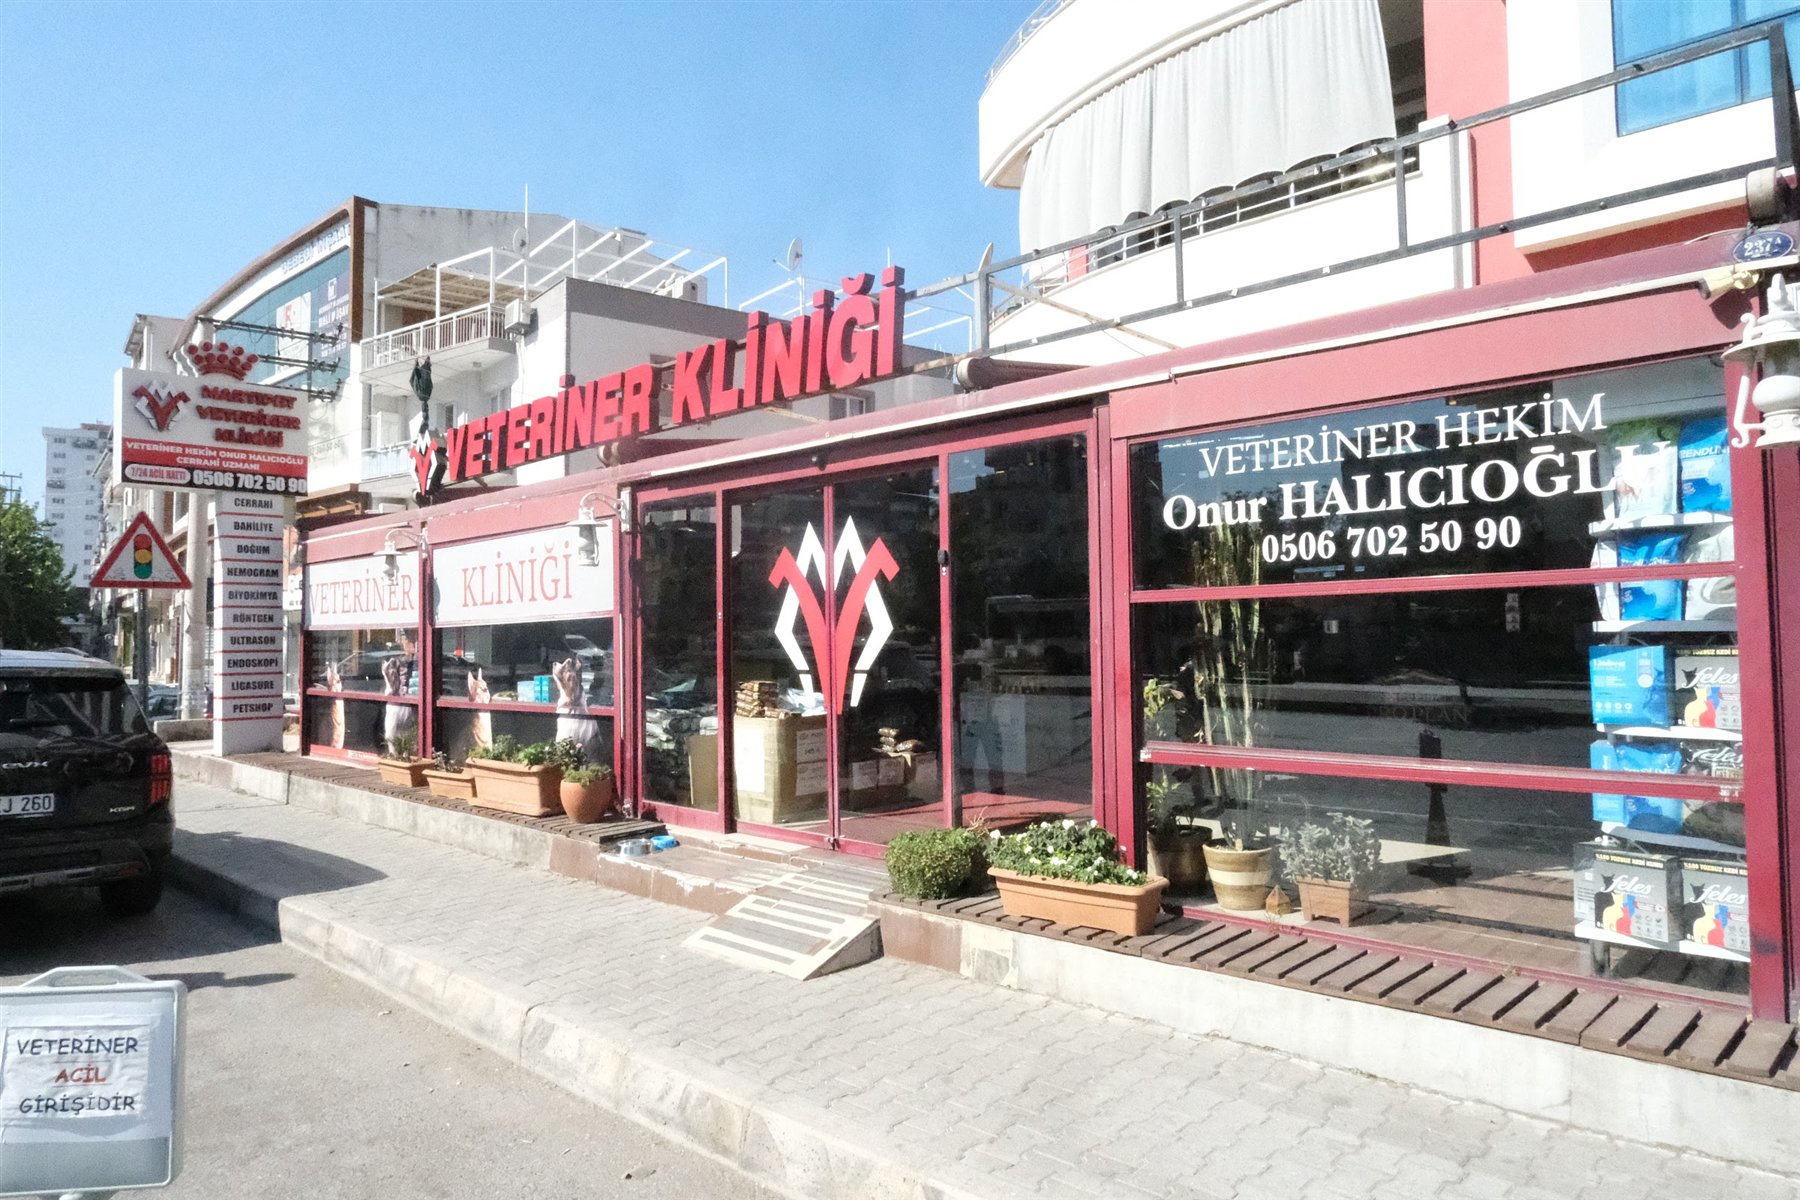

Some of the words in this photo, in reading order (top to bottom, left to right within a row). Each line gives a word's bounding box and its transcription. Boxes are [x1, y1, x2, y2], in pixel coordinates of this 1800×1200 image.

[447, 364, 660, 482] VETERİNER
[671, 266, 904, 424] KLİNİĞİ
[1199, 420, 1417, 479] VETERİNER
[1436, 392, 1608, 450] HEKİM
[126, 441, 183, 455] VETERİNER
[185, 446, 217, 458] HEKİM
[219, 450, 247, 460] ONUR
[248, 453, 304, 465] HALICIOĞLU
[176, 455, 220, 468] CERRAHİ
[222, 460, 260, 471] UZMANI
[192, 469, 234, 488] 0506
[237, 471, 263, 490] 702
[265, 474, 287, 491] 50
[288, 478, 308, 493] 90
[234, 497, 273, 509] CERRAHİ
[1162, 493, 1267, 530] Onur
[233, 521, 273, 532] DAHİLİYE
[1262, 530, 1336, 563] 0506
[1347, 524, 1408, 558] 702
[1420, 520, 1462, 552] 50
[1476, 514, 1522, 549] 90
[237, 543, 270, 555] DOĞUM
[227, 567, 279, 578] HEMOGRAM
[310, 568, 415, 615] VETERİNER
[462, 540, 574, 608] KLİNİĞİ
[228, 590, 278, 601] BİYOKİMYA
[233, 613, 274, 623] RÖNTGEN
[230, 636, 276, 646] ULTRASON
[227, 657, 279, 668] ENDOSKOPİ
[1681, 666, 1739, 688] feles
[233, 702, 274, 713] PETSHOP
[0, 797, 12, 813] J
[21, 795, 52, 812] 260
[1600, 874, 1653, 895] feles
[1689, 883, 1746, 904] feles
[16, 1035, 139, 1056] VETERİNER
[54, 1064, 108, 1084] ACİL
[19, 1091, 136, 1116] GİRİŞİDİR
